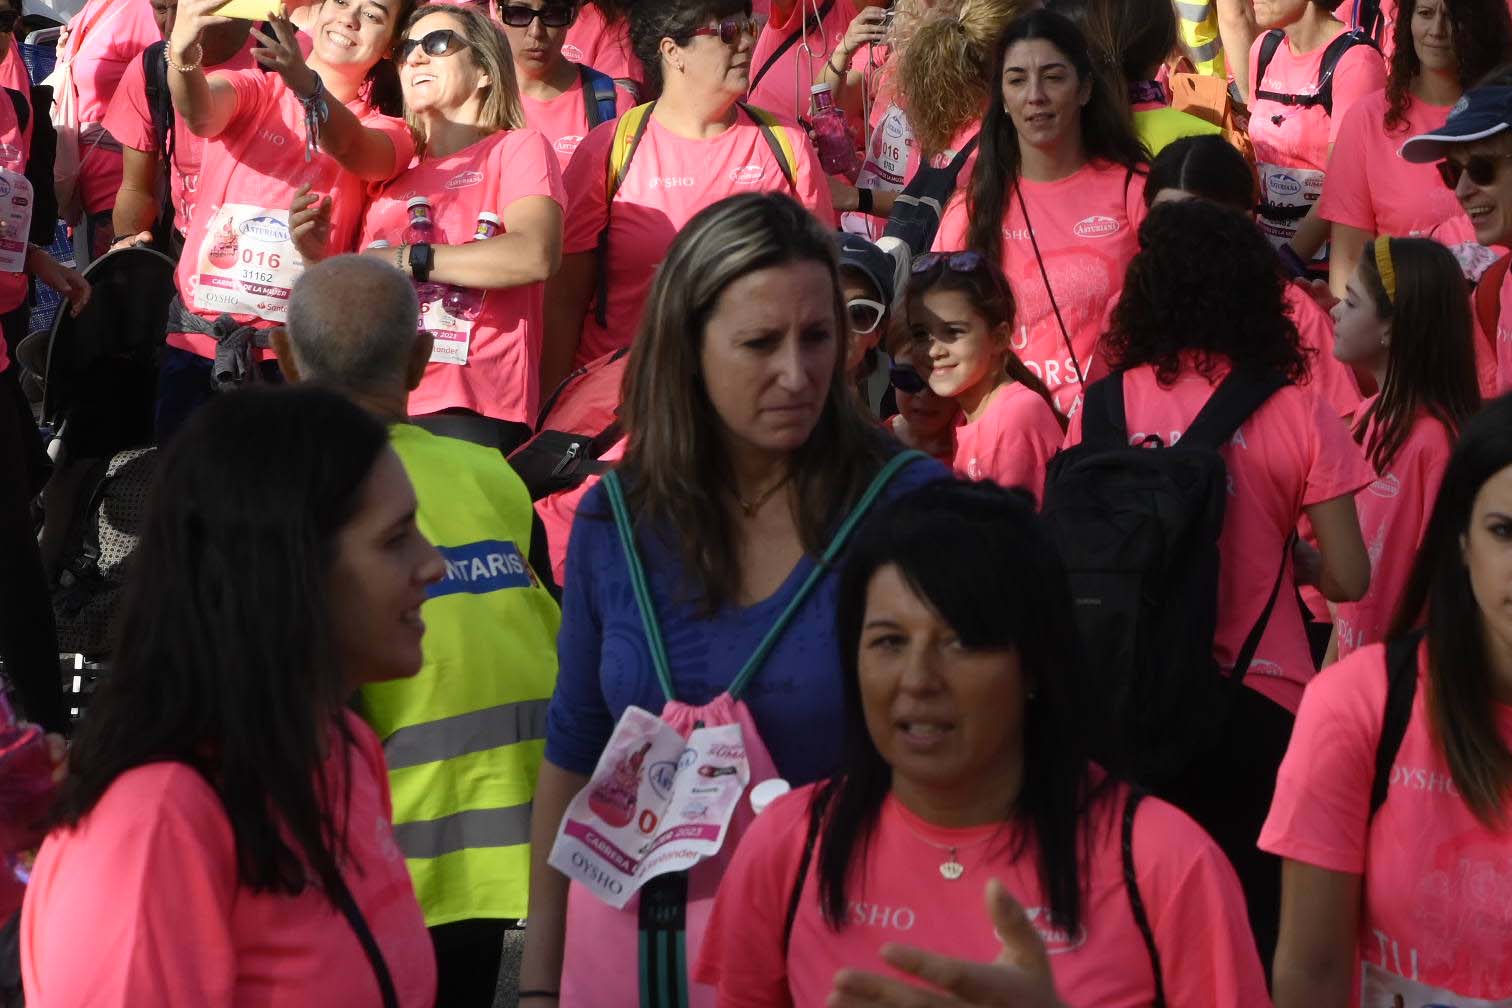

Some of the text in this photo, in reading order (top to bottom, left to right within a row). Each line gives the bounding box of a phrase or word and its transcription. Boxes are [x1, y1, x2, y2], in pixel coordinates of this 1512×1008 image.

[242, 248, 281, 269] 016
[242, 269, 273, 283] 31162
[585, 832, 630, 871] CARRERA
[570, 849, 624, 896] OYSHO
